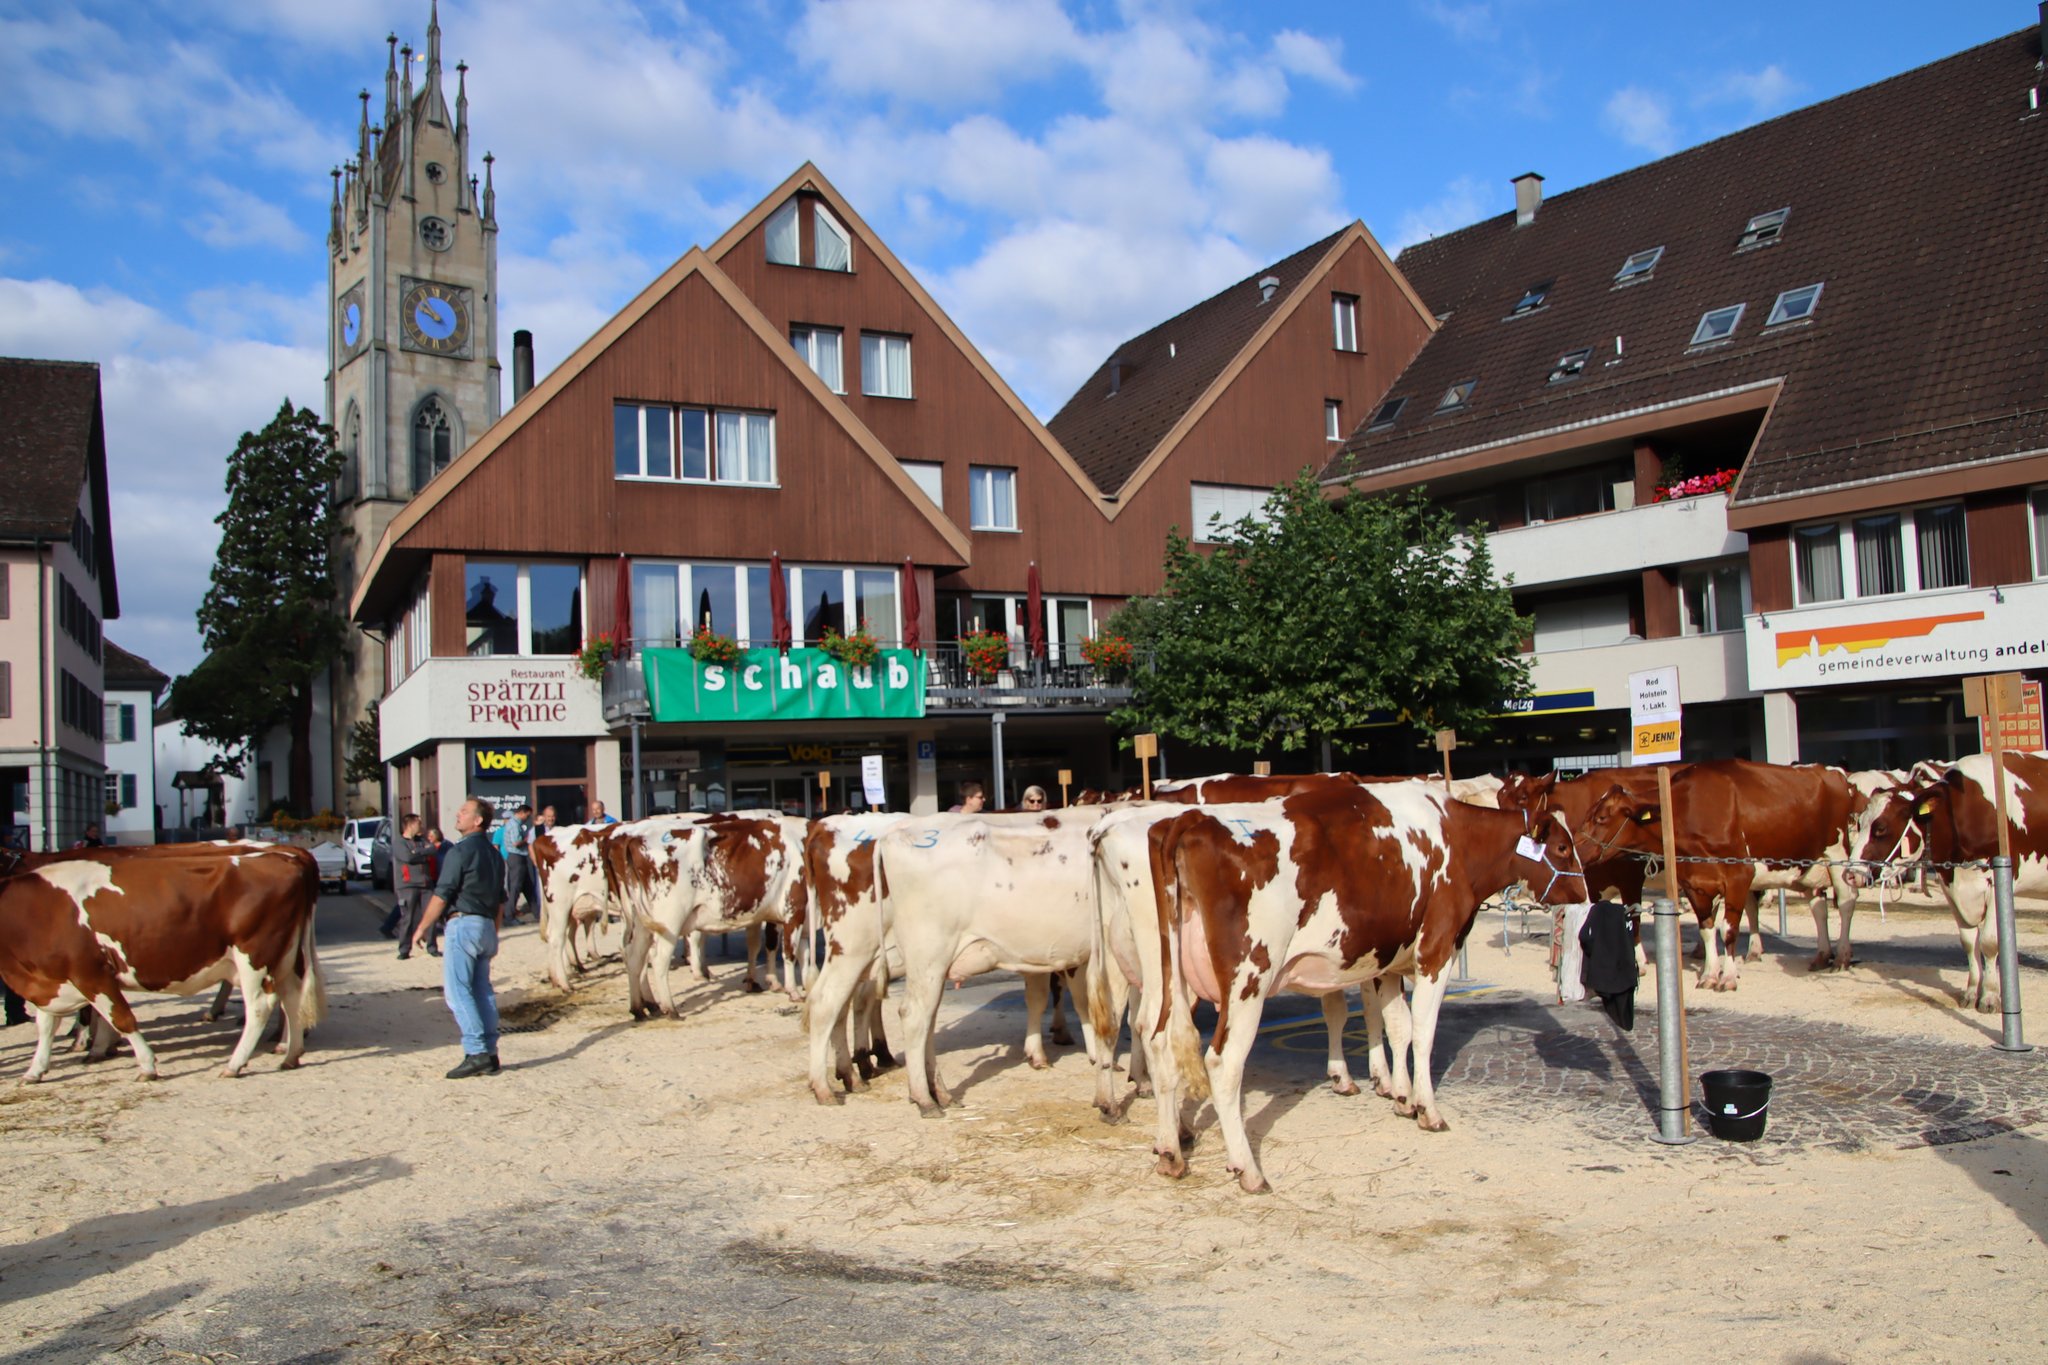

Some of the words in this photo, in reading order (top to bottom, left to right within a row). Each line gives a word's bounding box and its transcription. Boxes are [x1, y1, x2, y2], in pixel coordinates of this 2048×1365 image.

[1818, 646, 1989, 675] gemeindeverwaltung
[1995, 639, 2048, 656] andel
[511, 669, 565, 679] Restaurant
[704, 656, 909, 691] schaub
[1645, 678, 1659, 687] Red
[1639, 689, 1668, 700] Holstein
[1503, 699, 1534, 712] Metzg
[1650, 702, 1667, 711] Lakt.
[1651, 731, 1675, 743] JENNI
[788, 744, 832, 764] Volg
[476, 750, 528, 773] Volg
[912, 829, 940, 849] 3
